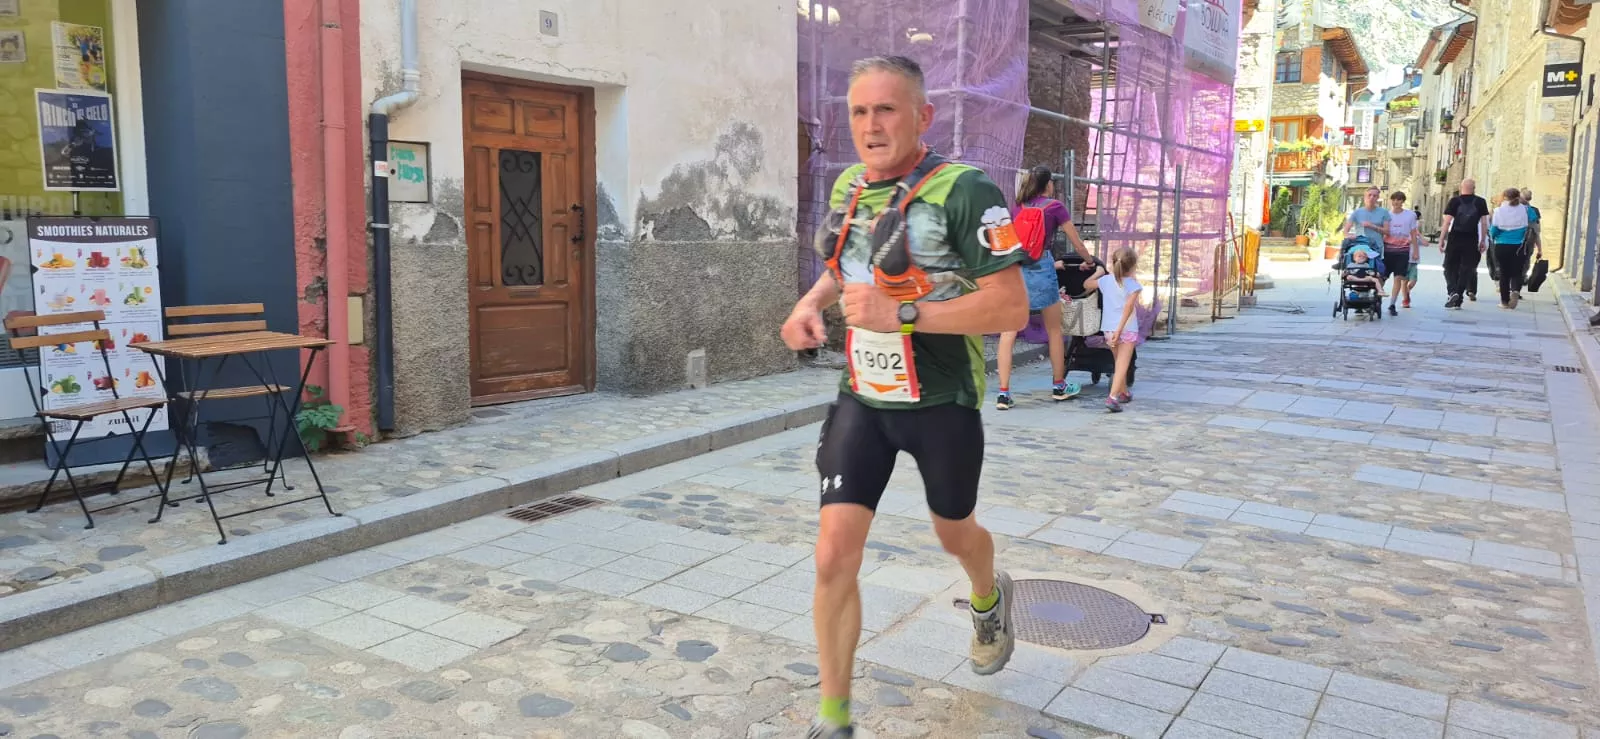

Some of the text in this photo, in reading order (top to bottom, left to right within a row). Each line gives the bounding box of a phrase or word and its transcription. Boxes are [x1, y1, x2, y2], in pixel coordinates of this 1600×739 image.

[545, 17, 552, 29] 9
[37, 225, 148, 237] SMOOTHIES NATURALES
[854, 348, 903, 370] 1902
